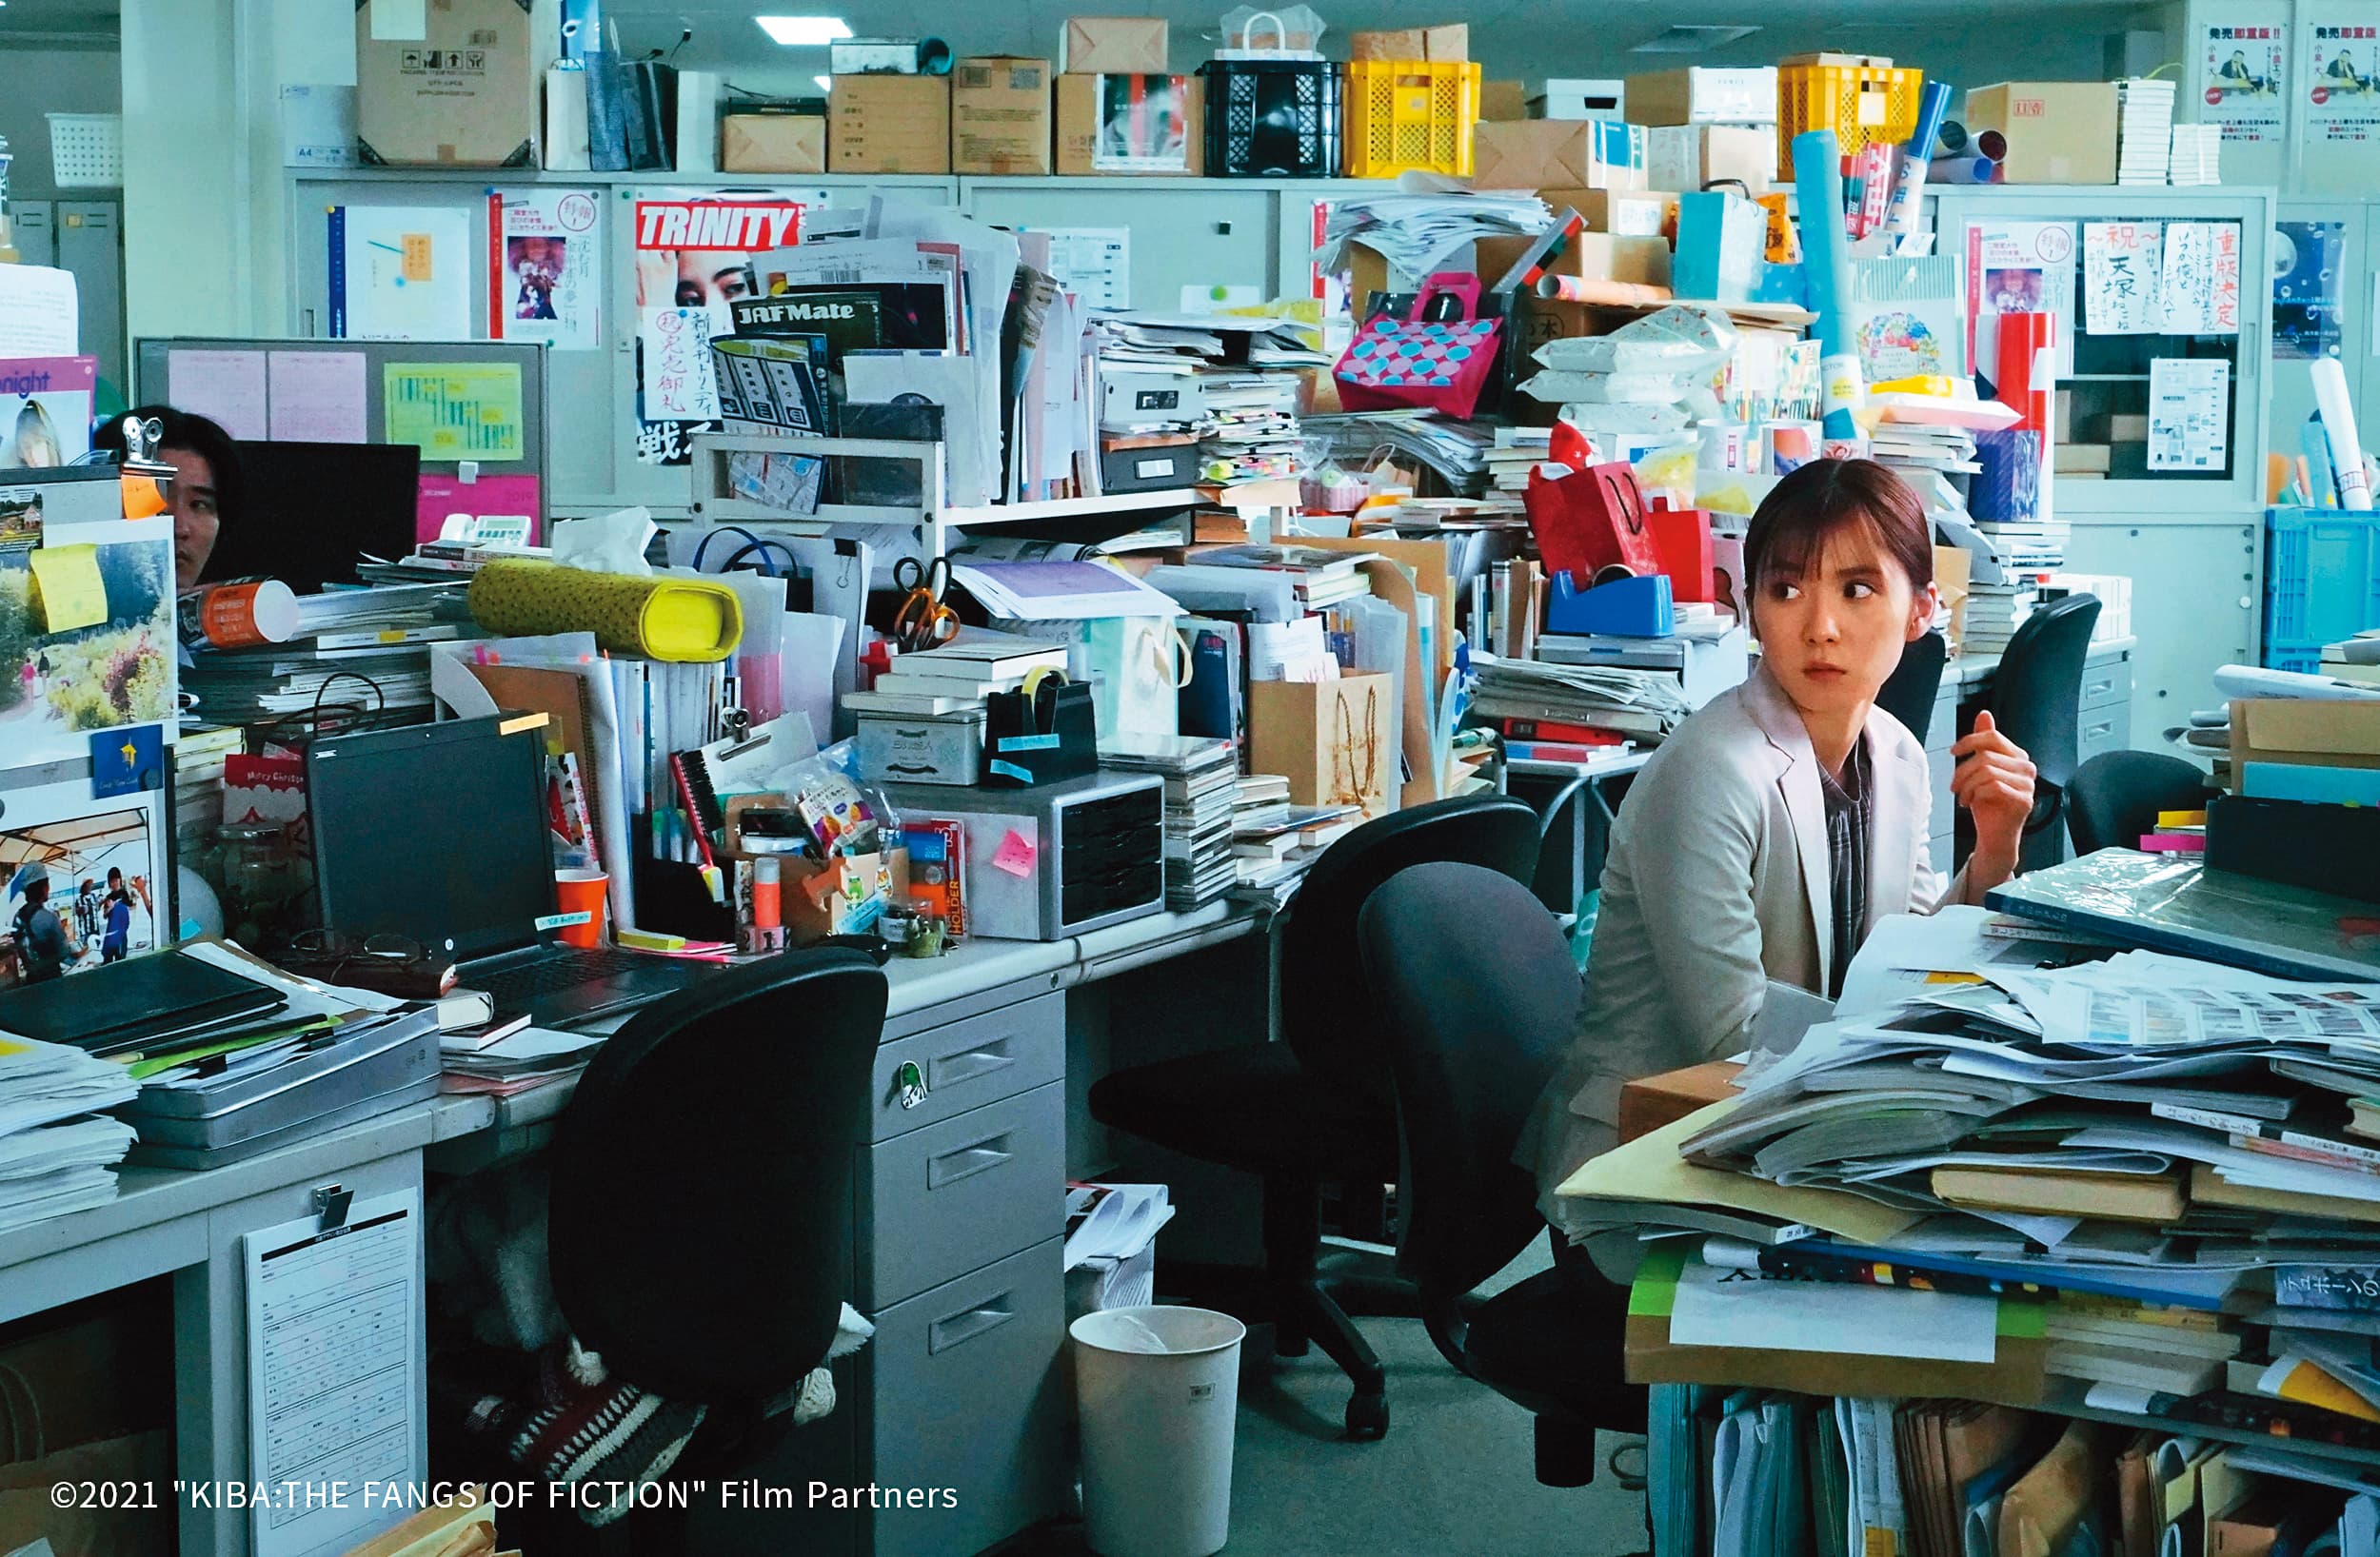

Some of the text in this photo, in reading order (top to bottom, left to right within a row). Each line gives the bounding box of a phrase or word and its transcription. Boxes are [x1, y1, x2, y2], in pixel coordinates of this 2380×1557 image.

[640, 206, 798, 247] TRINITY
[2213, 228, 2239, 328] 重版決定
[0, 369, 51, 399] night
[948, 880, 961, 935] HOLDER
